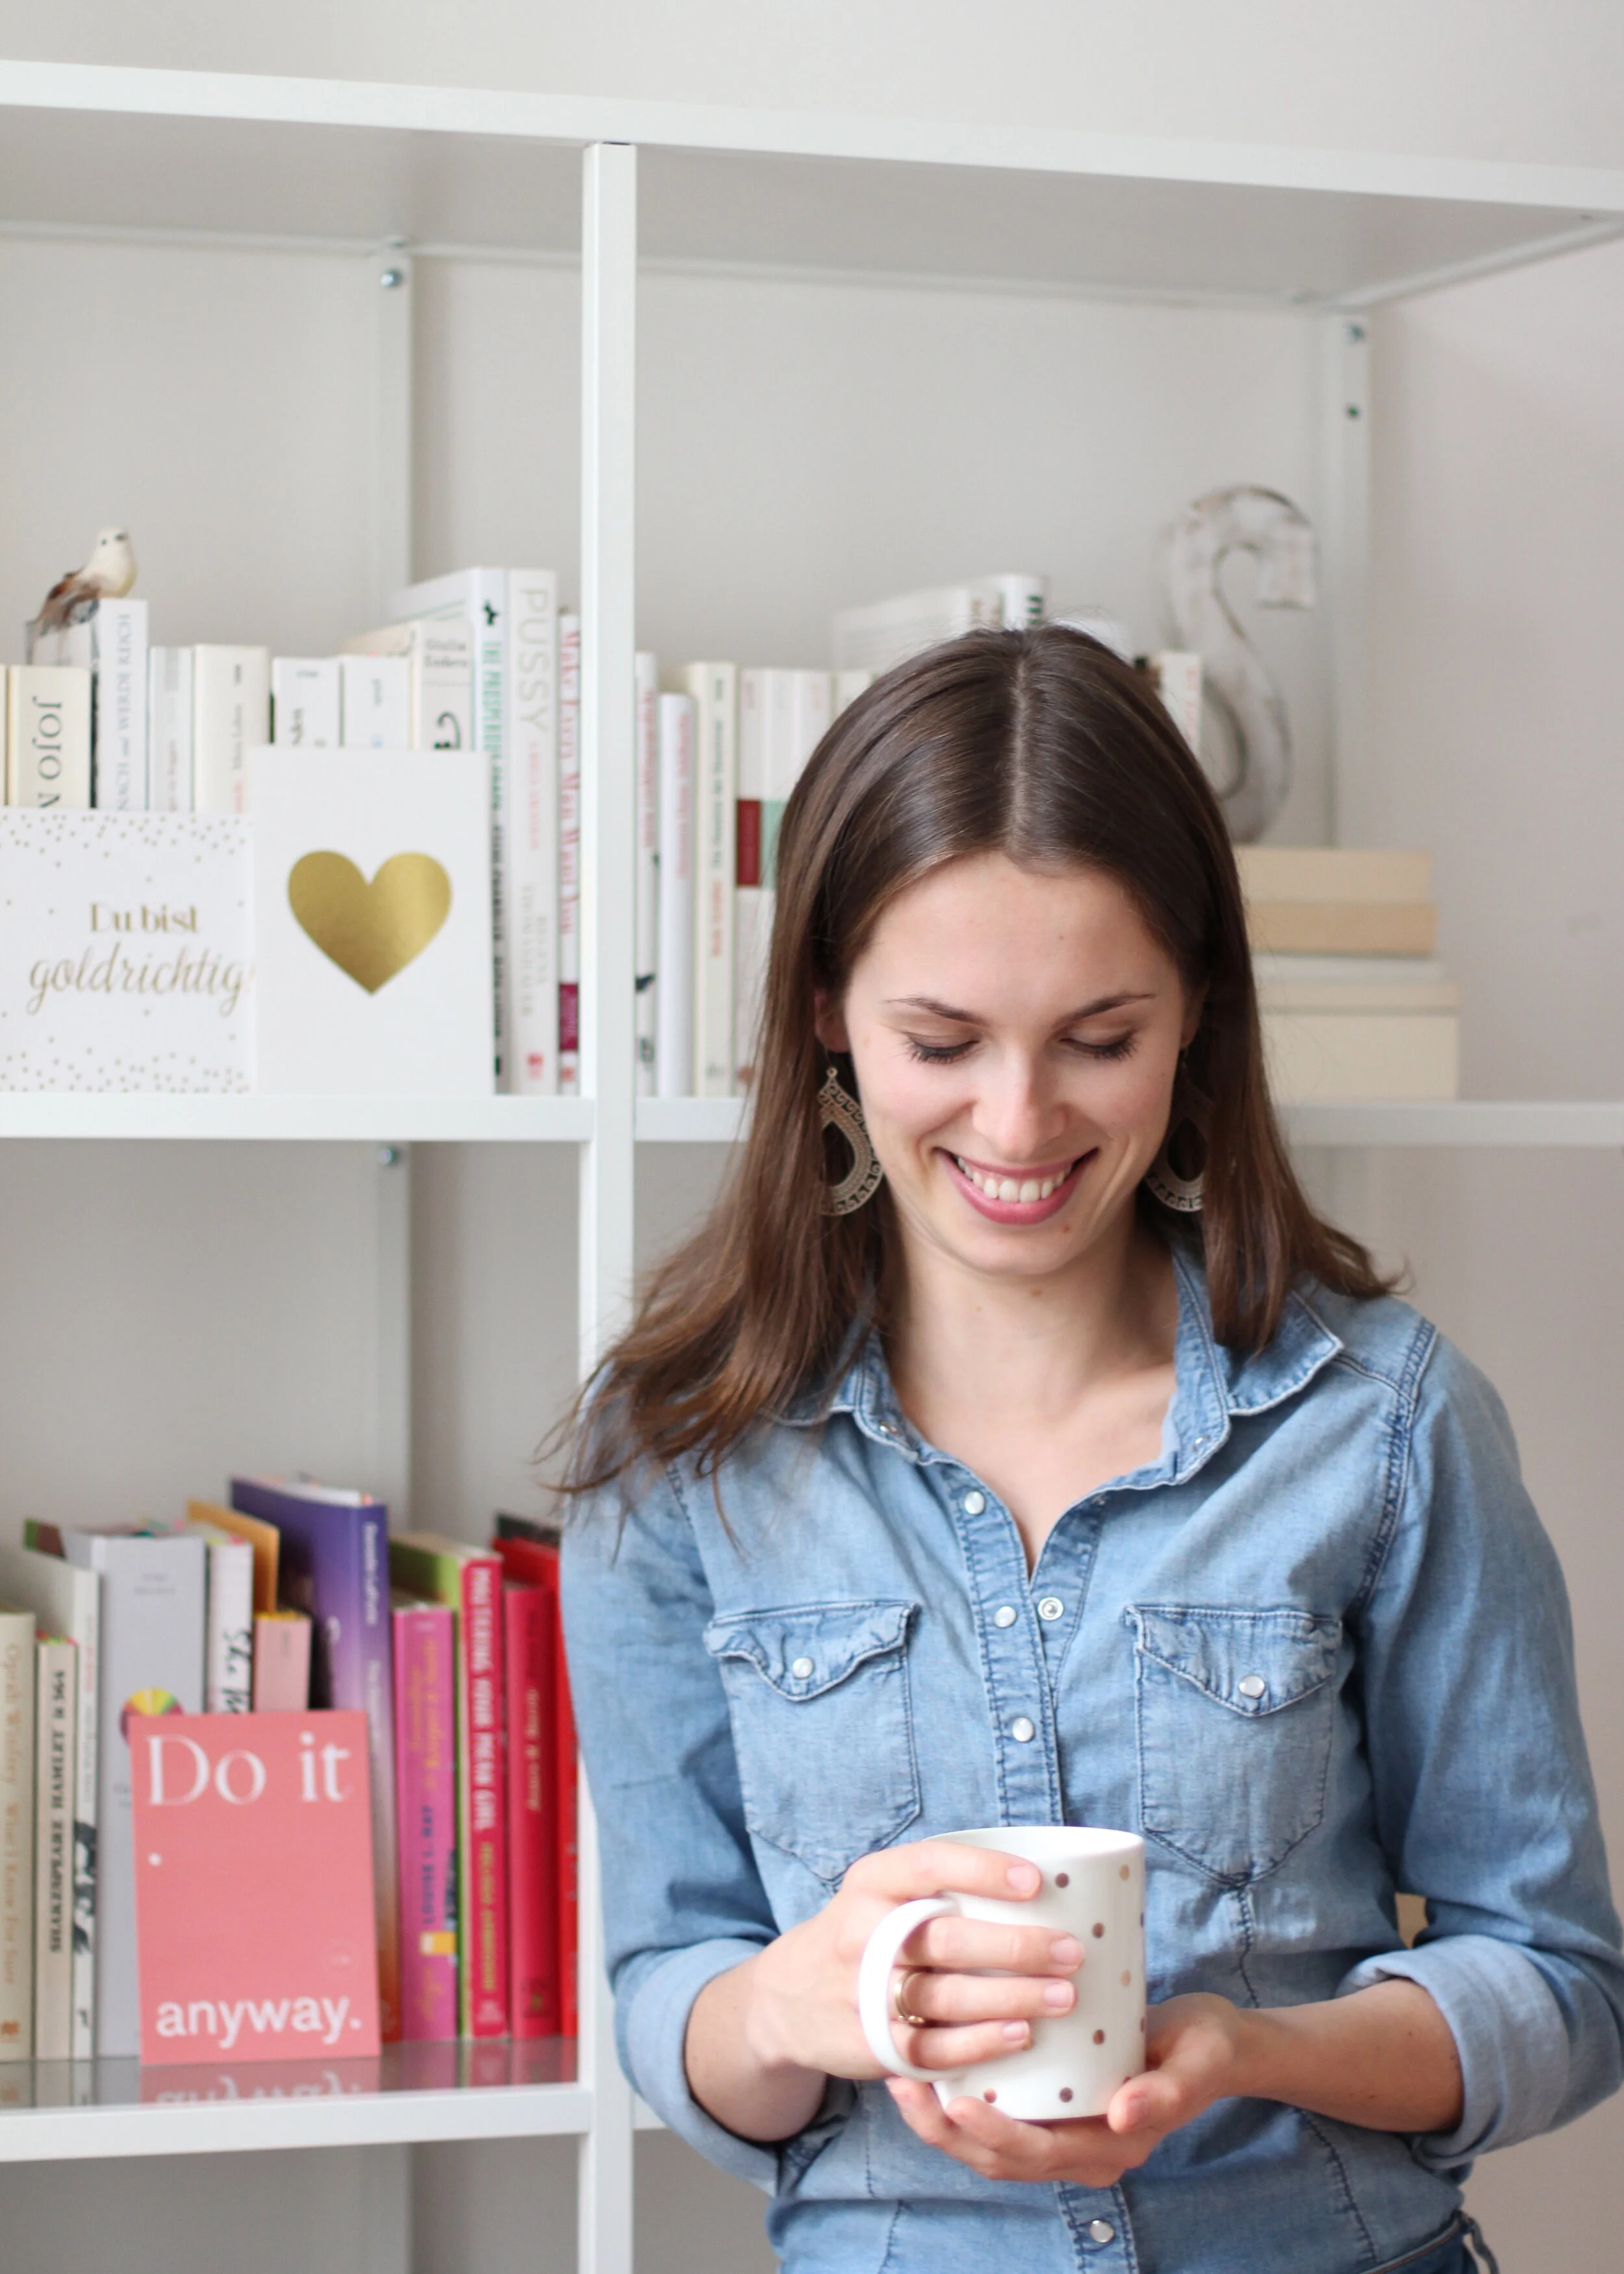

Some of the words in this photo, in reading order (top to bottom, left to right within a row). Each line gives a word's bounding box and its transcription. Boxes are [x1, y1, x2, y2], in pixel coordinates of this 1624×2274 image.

[518, 587, 549, 732] PUSSY
[32, 696, 62, 779] JOJO
[91, 903, 131, 932] Du
[141, 903, 199, 933] bist
[51, 1730, 64, 1810] HAMLET
[147, 1733, 266, 1806] Do
[299, 1731, 352, 1802] it
[50, 1821, 64, 1952] SHAKESPEARE
[156, 1995, 362, 2050] anyway.
